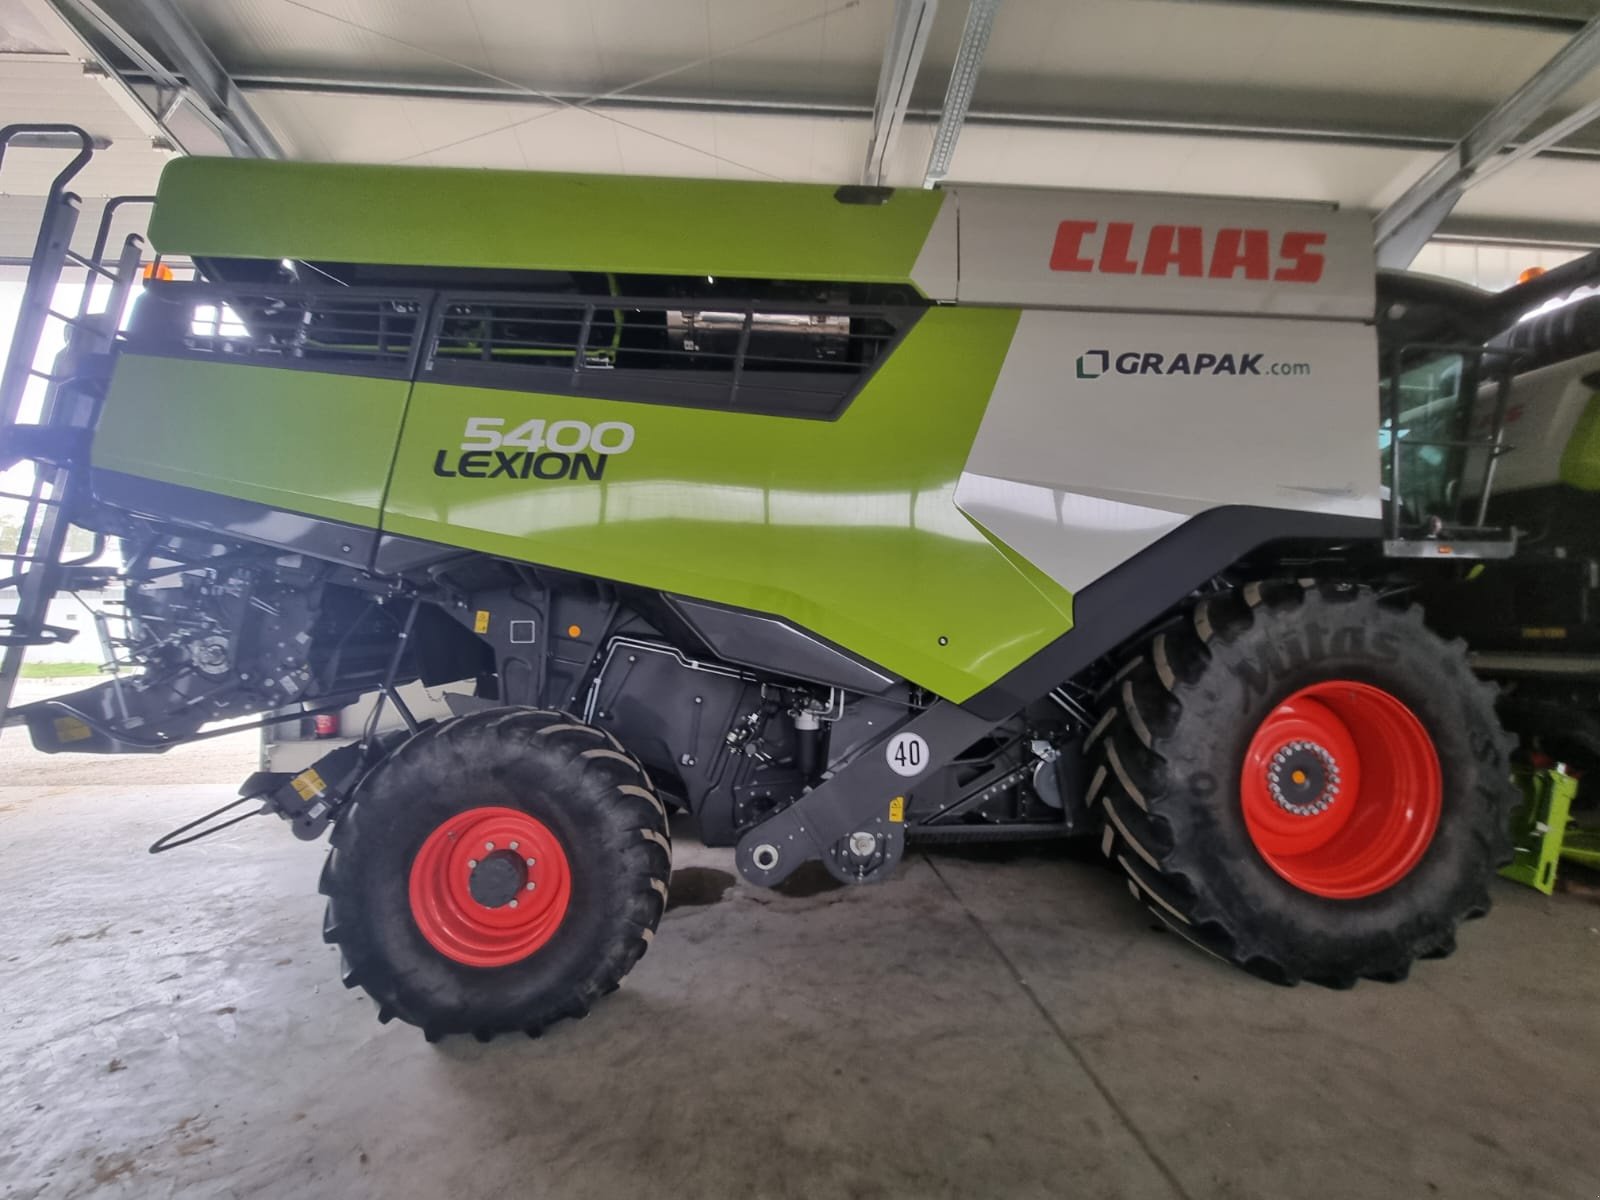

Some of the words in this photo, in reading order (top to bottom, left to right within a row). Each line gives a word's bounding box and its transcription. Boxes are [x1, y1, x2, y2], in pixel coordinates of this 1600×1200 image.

[1049, 220, 1327, 283] CLAAS
[1115, 353, 1311, 375] GRAPAK.com
[461, 417, 635, 454] 5400
[434, 449, 608, 481] LEXION
[895, 740, 920, 767] 40
